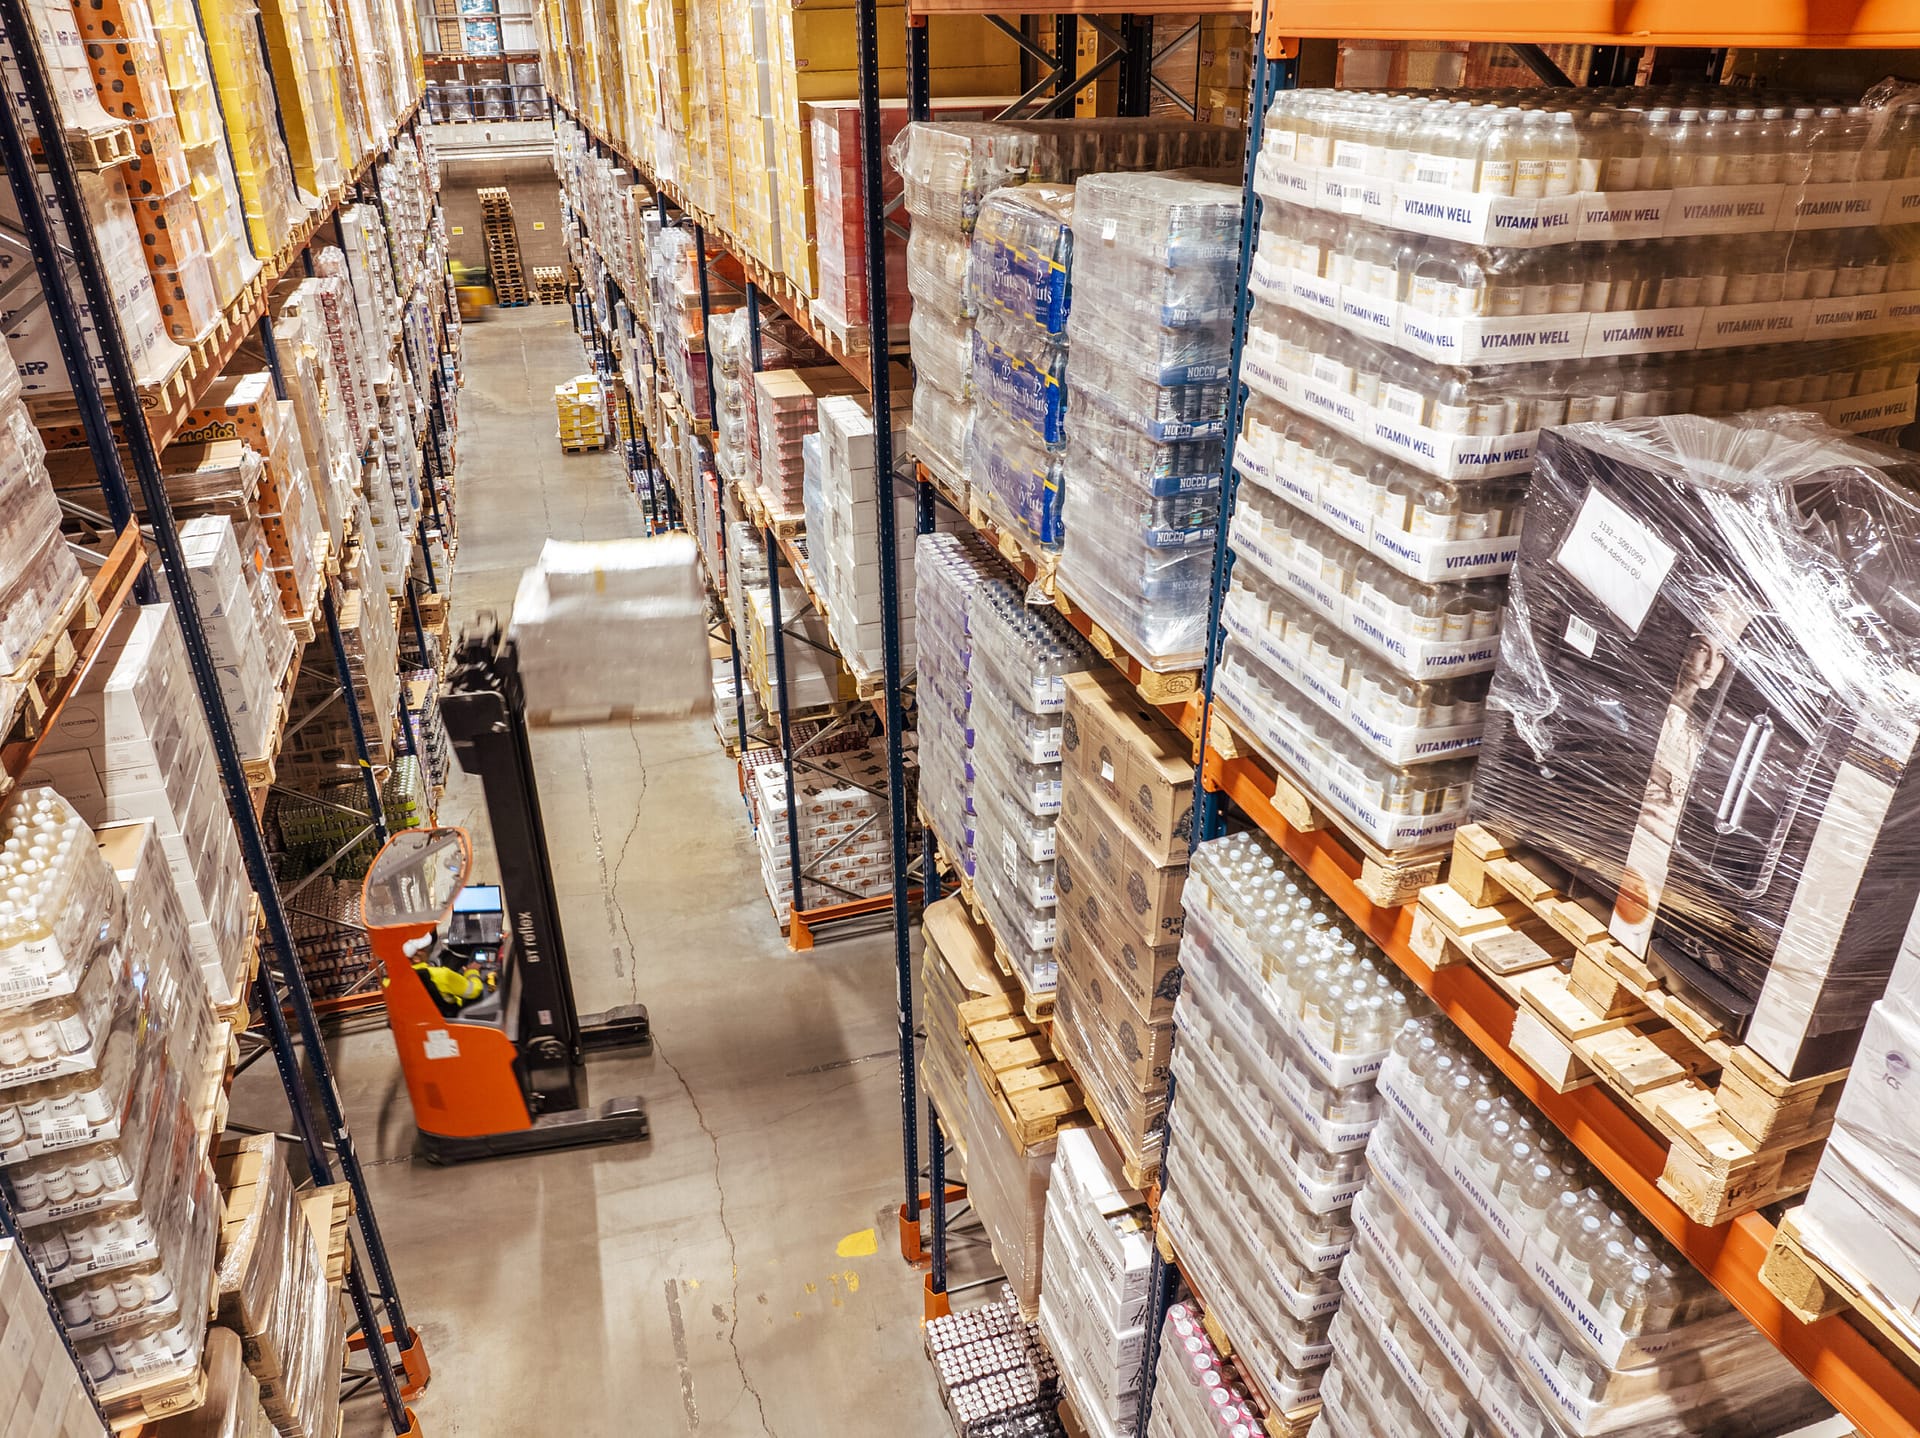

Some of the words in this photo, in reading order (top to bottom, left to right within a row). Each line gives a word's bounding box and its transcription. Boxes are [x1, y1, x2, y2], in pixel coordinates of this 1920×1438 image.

[1404, 199, 1445, 219] VITAMIN
[1447, 205, 1472, 224] WELL
[1542, 213, 1570, 227] WELL
[1586, 209, 1632, 223] VITAMIN
[1633, 208, 1660, 221] WELL
[1683, 203, 1735, 219] VITAMIN
[1736, 202, 1766, 217] WELL
[1795, 201, 1846, 217] VITAMIN
[1846, 198, 1873, 213] WELL
[1293, 285, 1319, 302] VITAMIN
[1319, 294, 1335, 308] WELL
[1343, 302, 1371, 321] VITAMIN
[1372, 311, 1391, 327] WELL
[1716, 319, 1765, 335] VITAMIN
[1766, 315, 1794, 331] WELL
[1815, 311, 1855, 325] VITAMIN
[1855, 308, 1878, 322] WELL
[1404, 322, 1435, 344] VITAMIN
[1481, 332, 1536, 348] VITAMIN
[1538, 330, 1570, 345] WELL
[1602, 327, 1653, 343] VITAMIN
[1655, 324, 1685, 340] WELL
[1186, 364, 1216, 379] NOCCO
[1245, 360, 1272, 384] VITAMIN
[1272, 375, 1289, 392] WELL
[1304, 388, 1335, 413] VITAMIN
[1335, 403, 1356, 421] WELL
[1839, 407, 1882, 425] VITAMIN
[1883, 401, 1908, 419] WELL
[1164, 423, 1192, 436] NOCCO
[1374, 423, 1412, 450] VITAMIN
[1412, 440, 1435, 458] WELL
[1503, 448, 1530, 461] WELL
[1179, 475, 1207, 489] NOCCO
[1274, 474, 1299, 495] VITAMIN
[1299, 488, 1314, 504] WELL
[1321, 501, 1349, 525] VITAMIN
[1349, 517, 1366, 533] WELL
[1156, 530, 1185, 543] NOCCO
[1234, 530, 1257, 558] VITAMIN
[1257, 548, 1273, 568] WELL
[1374, 530, 1405, 558] VITAMIN
[1404, 547, 1422, 564] WELL
[1446, 552, 1498, 568] VITAMIN
[1499, 550, 1517, 563] WE
[1590, 531, 1609, 551] Coffee
[1608, 548, 1630, 572] Address
[1287, 571, 1316, 598] VITAMIN
[1315, 589, 1334, 610] WELL
[1352, 614, 1385, 643] VITAMIN
[1385, 636, 1406, 658] WELL
[1466, 649, 1493, 662] WELL
[1219, 681, 1242, 707] VITAMIN
[1241, 702, 1256, 723] WELL
[1301, 672, 1327, 698] VITAMIN
[1327, 689, 1342, 709] WELL
[1351, 711, 1376, 740] VITAMIN
[1375, 728, 1393, 748] WELL
[1268, 727, 1296, 757] VITAMIN
[1295, 749, 1312, 773] WELL
[1415, 740, 1465, 754] VITAMIN
[1465, 737, 1483, 747] WE
[1327, 780, 1356, 811] VITAMIN
[1356, 803, 1377, 829] WELL
[1395, 825, 1433, 838] VITAMIN
[1433, 821, 1457, 834] WELL
[525, 949, 541, 963] BT
[1318, 1051, 1334, 1072] WELL
[1352, 1061, 1383, 1075] VITAM
[1279, 1080, 1303, 1116] VITAMIN
[1304, 1112, 1321, 1136] WELL
[1385, 1082, 1416, 1120] VITAMIN
[1415, 1118, 1435, 1146] WELL
[1337, 1131, 1370, 1143] VITAMN
[1298, 1178, 1314, 1200] WELL
[48, 1198, 103, 1217] Belief
[1453, 1166, 1488, 1211] VITAMIN
[1489, 1207, 1512, 1240] WELL
[1358, 1212, 1385, 1253] VITAMIN
[1385, 1249, 1403, 1281] WELL
[1413, 1207, 1441, 1246] VITAMIN
[1440, 1242, 1458, 1269] WELL
[1466, 1278, 1496, 1321] VITAMIN
[1496, 1314, 1516, 1345] WELL
[1535, 1261, 1576, 1317] VITAMIN
[1577, 1309, 1605, 1346] WELL
[1418, 1301, 1449, 1350] VITAMIN
[1450, 1342, 1470, 1379] WELL
[1407, 1372, 1425, 1397] WELL
[1528, 1352, 1560, 1400] VITAMIN
